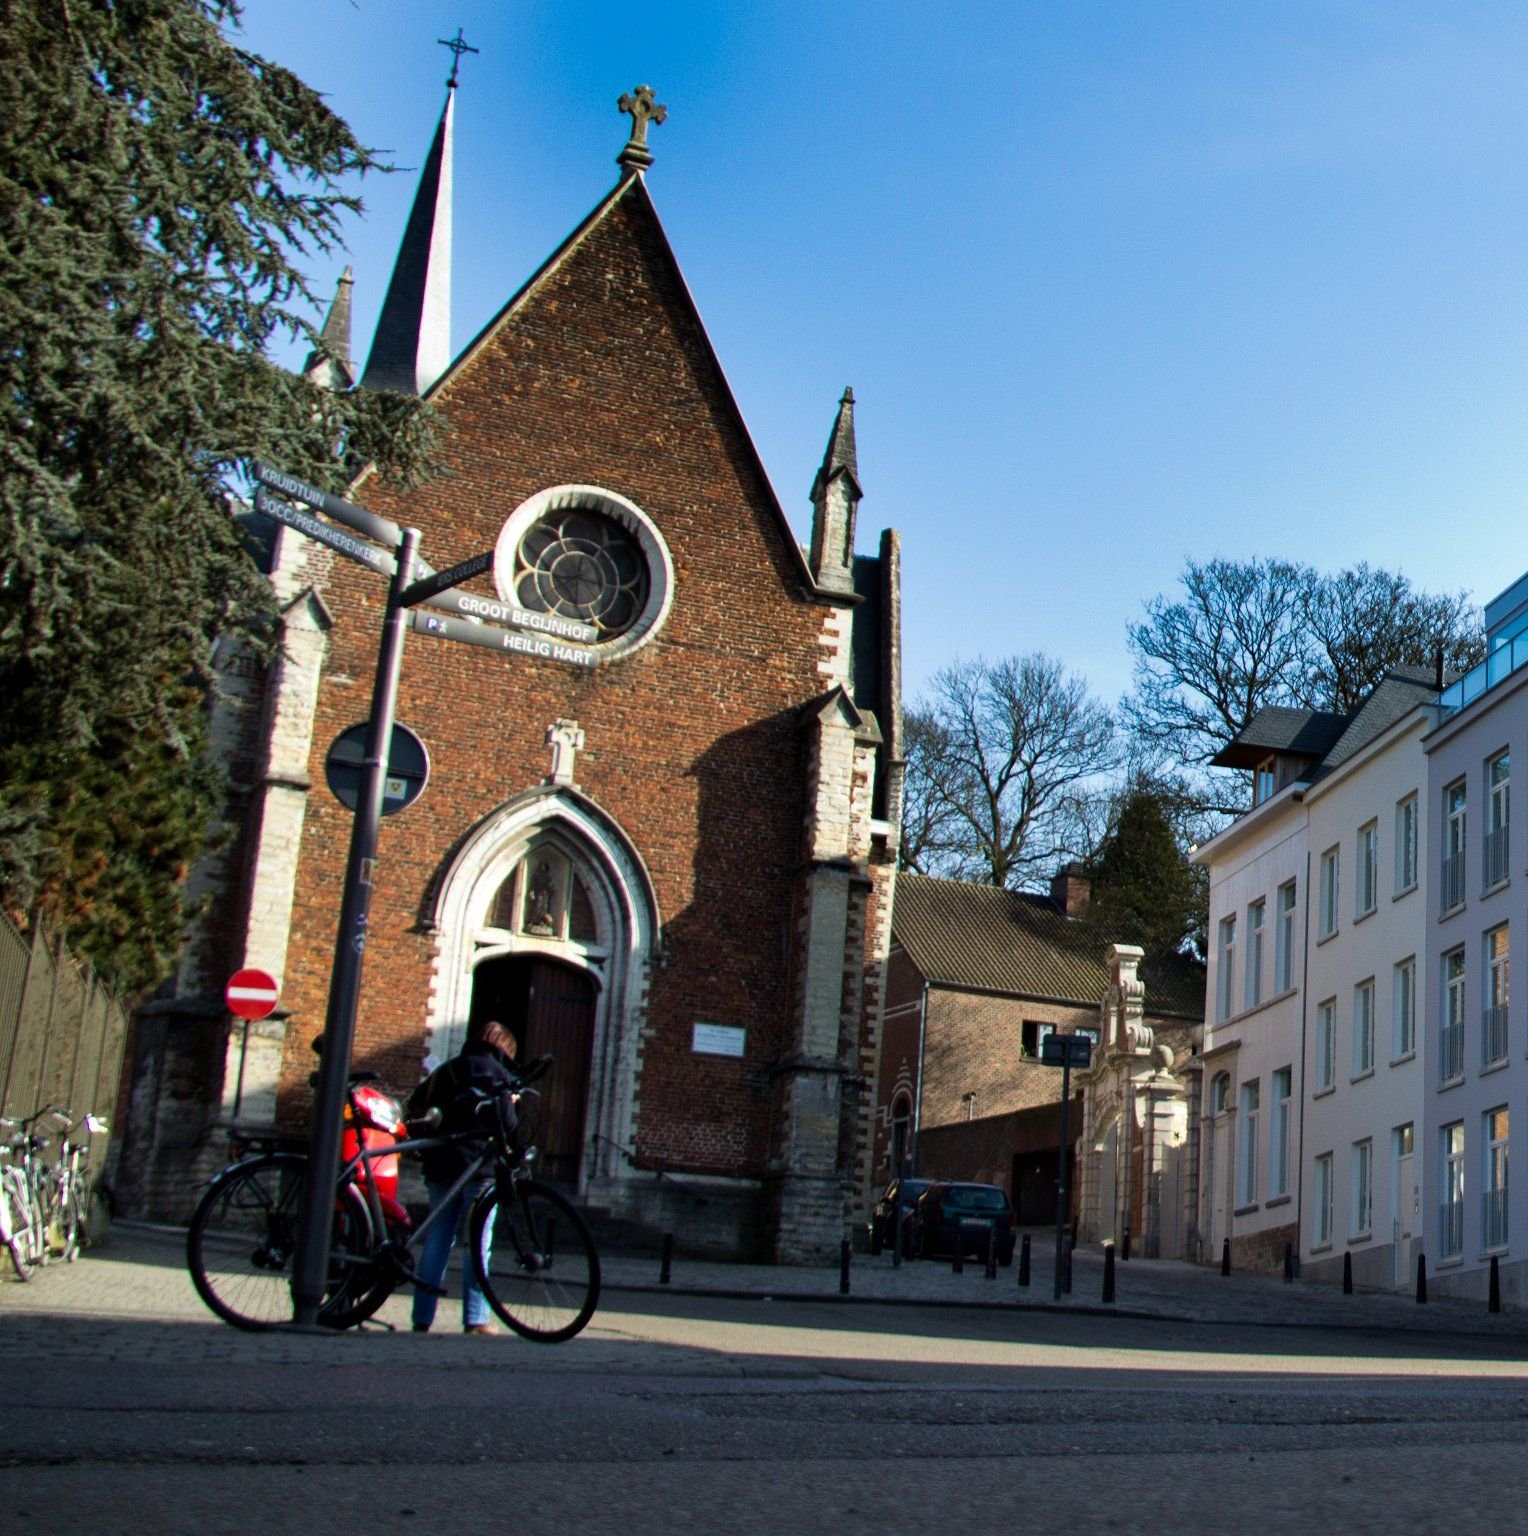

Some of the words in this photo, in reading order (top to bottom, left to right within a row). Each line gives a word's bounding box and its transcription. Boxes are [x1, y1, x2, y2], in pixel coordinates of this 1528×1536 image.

[261, 466, 325, 507] KRUIDTUIN
[453, 554, 488, 580] COLLEGE
[458, 596, 510, 621] GROOT
[511, 609, 592, 642] BEGIJNHOF
[503, 634, 550, 657] HEILIG
[552, 646, 593, 667] HART
